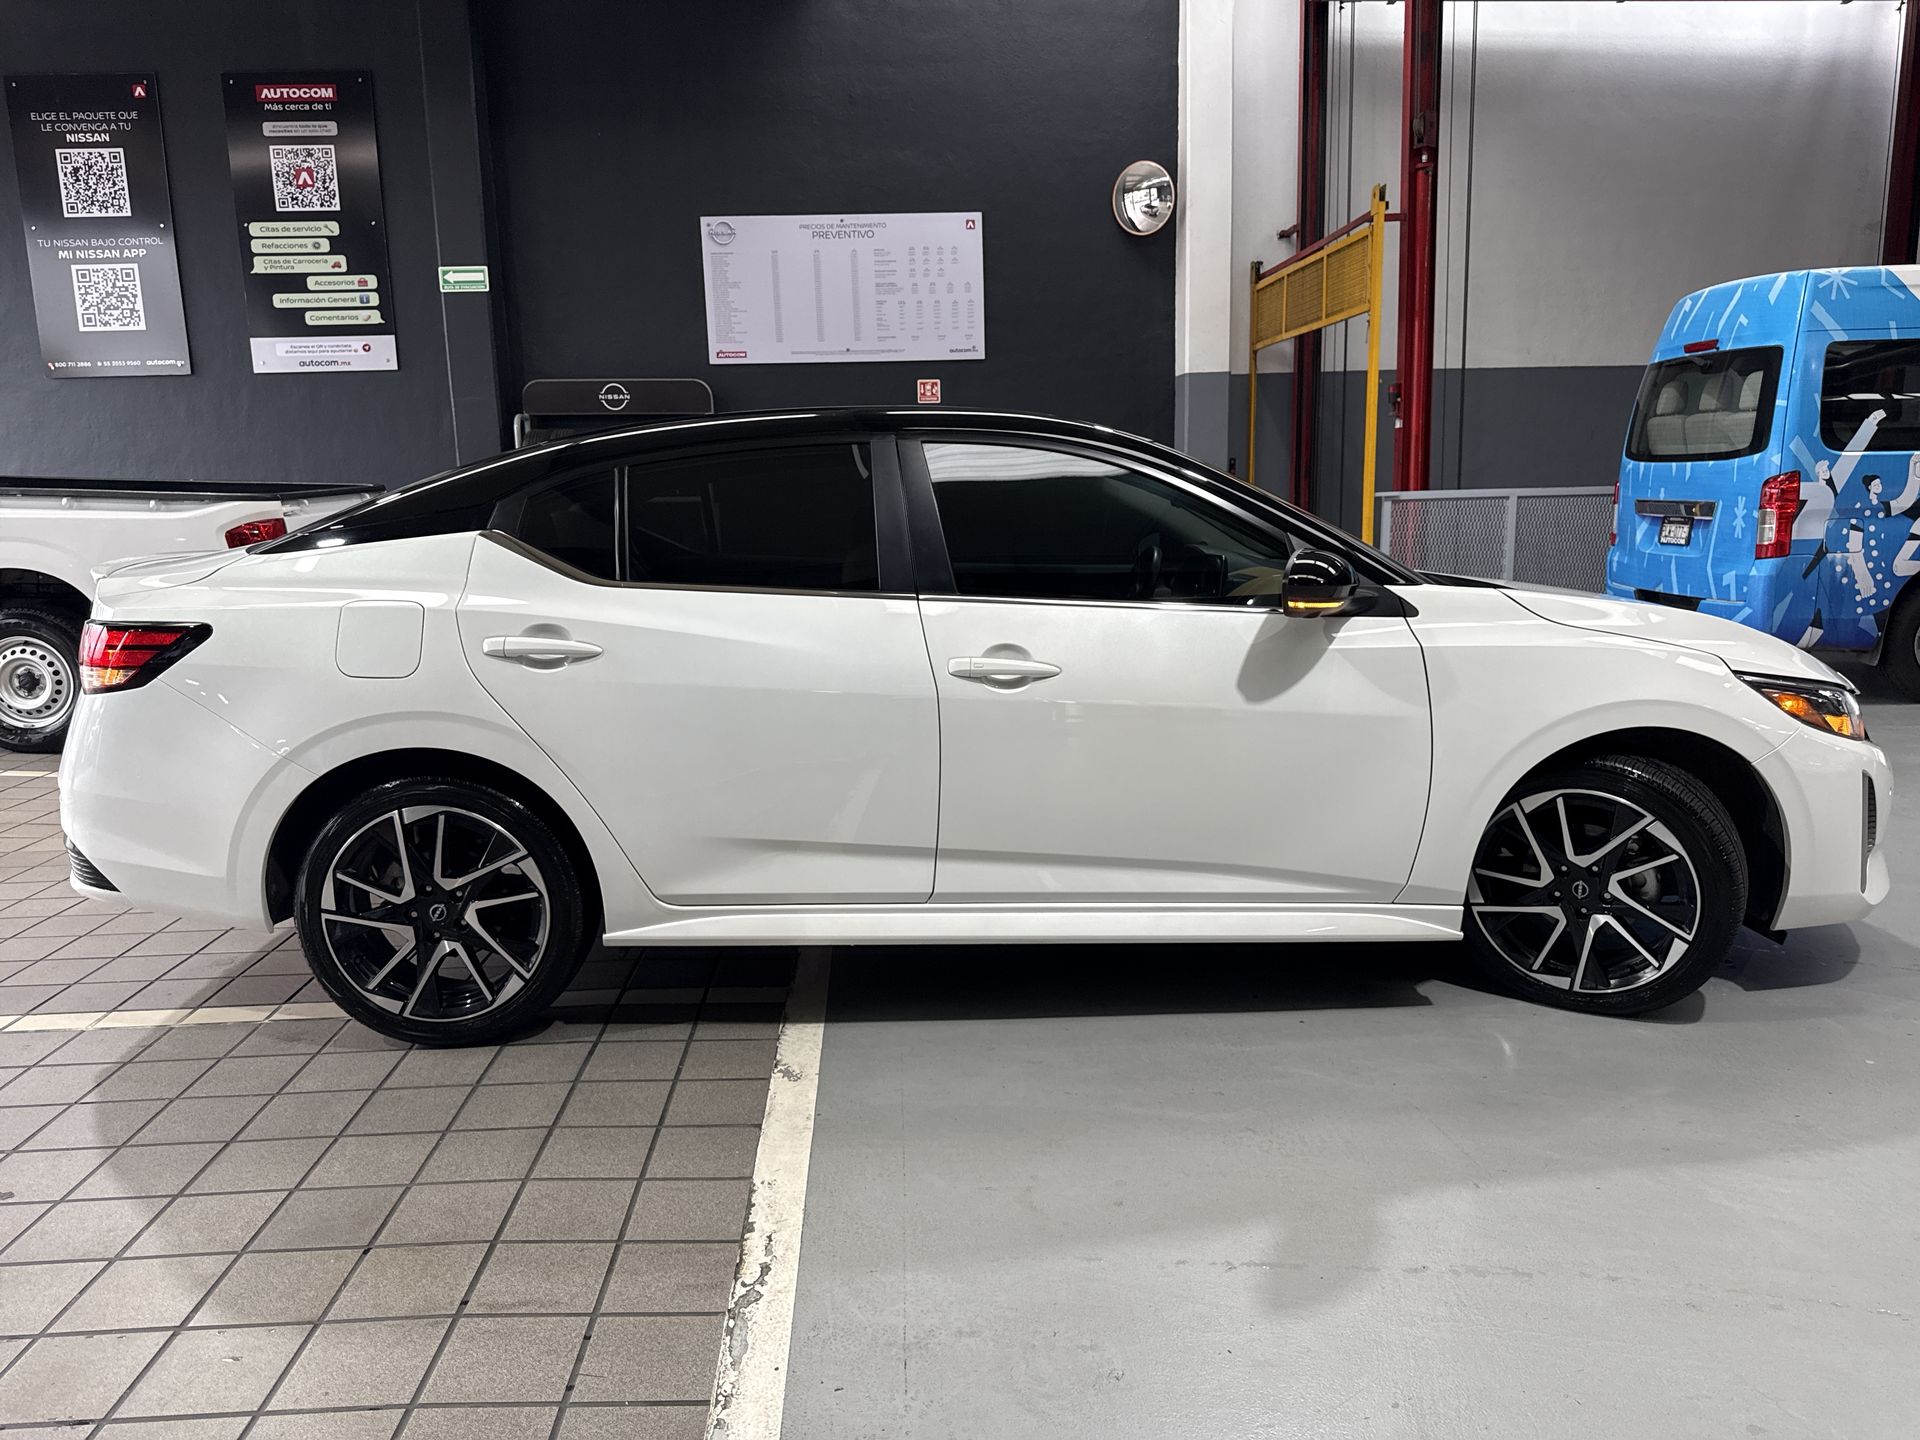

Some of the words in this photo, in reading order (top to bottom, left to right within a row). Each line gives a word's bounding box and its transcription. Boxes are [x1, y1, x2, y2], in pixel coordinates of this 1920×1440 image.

[260, 88, 333, 98] AUTOCOM
[264, 102, 283, 111] Más
[30, 112, 57, 121] ELIGE
[59, 112, 71, 120] EL
[72, 111, 116, 120] PAQUETE
[118, 111, 139, 120] QUE
[41, 123, 53, 132] LE
[54, 122, 109, 132] CONVENGA
[110, 122, 117, 131] A
[118, 122, 131, 131] TU
[66, 133, 110, 142] NISSAN
[281, 225, 291, 233] de
[811, 229, 875, 240] PREVENTIVO
[37, 239, 51, 248] TU
[53, 239, 88, 248] NISSAN
[91, 238, 116, 247] BAJO
[118, 237, 163, 246] CONTROL
[58, 250, 73, 260] MI
[75, 249, 120, 259] NISSAN
[123, 248, 146, 258] APP
[279, 296, 326, 304] Información
